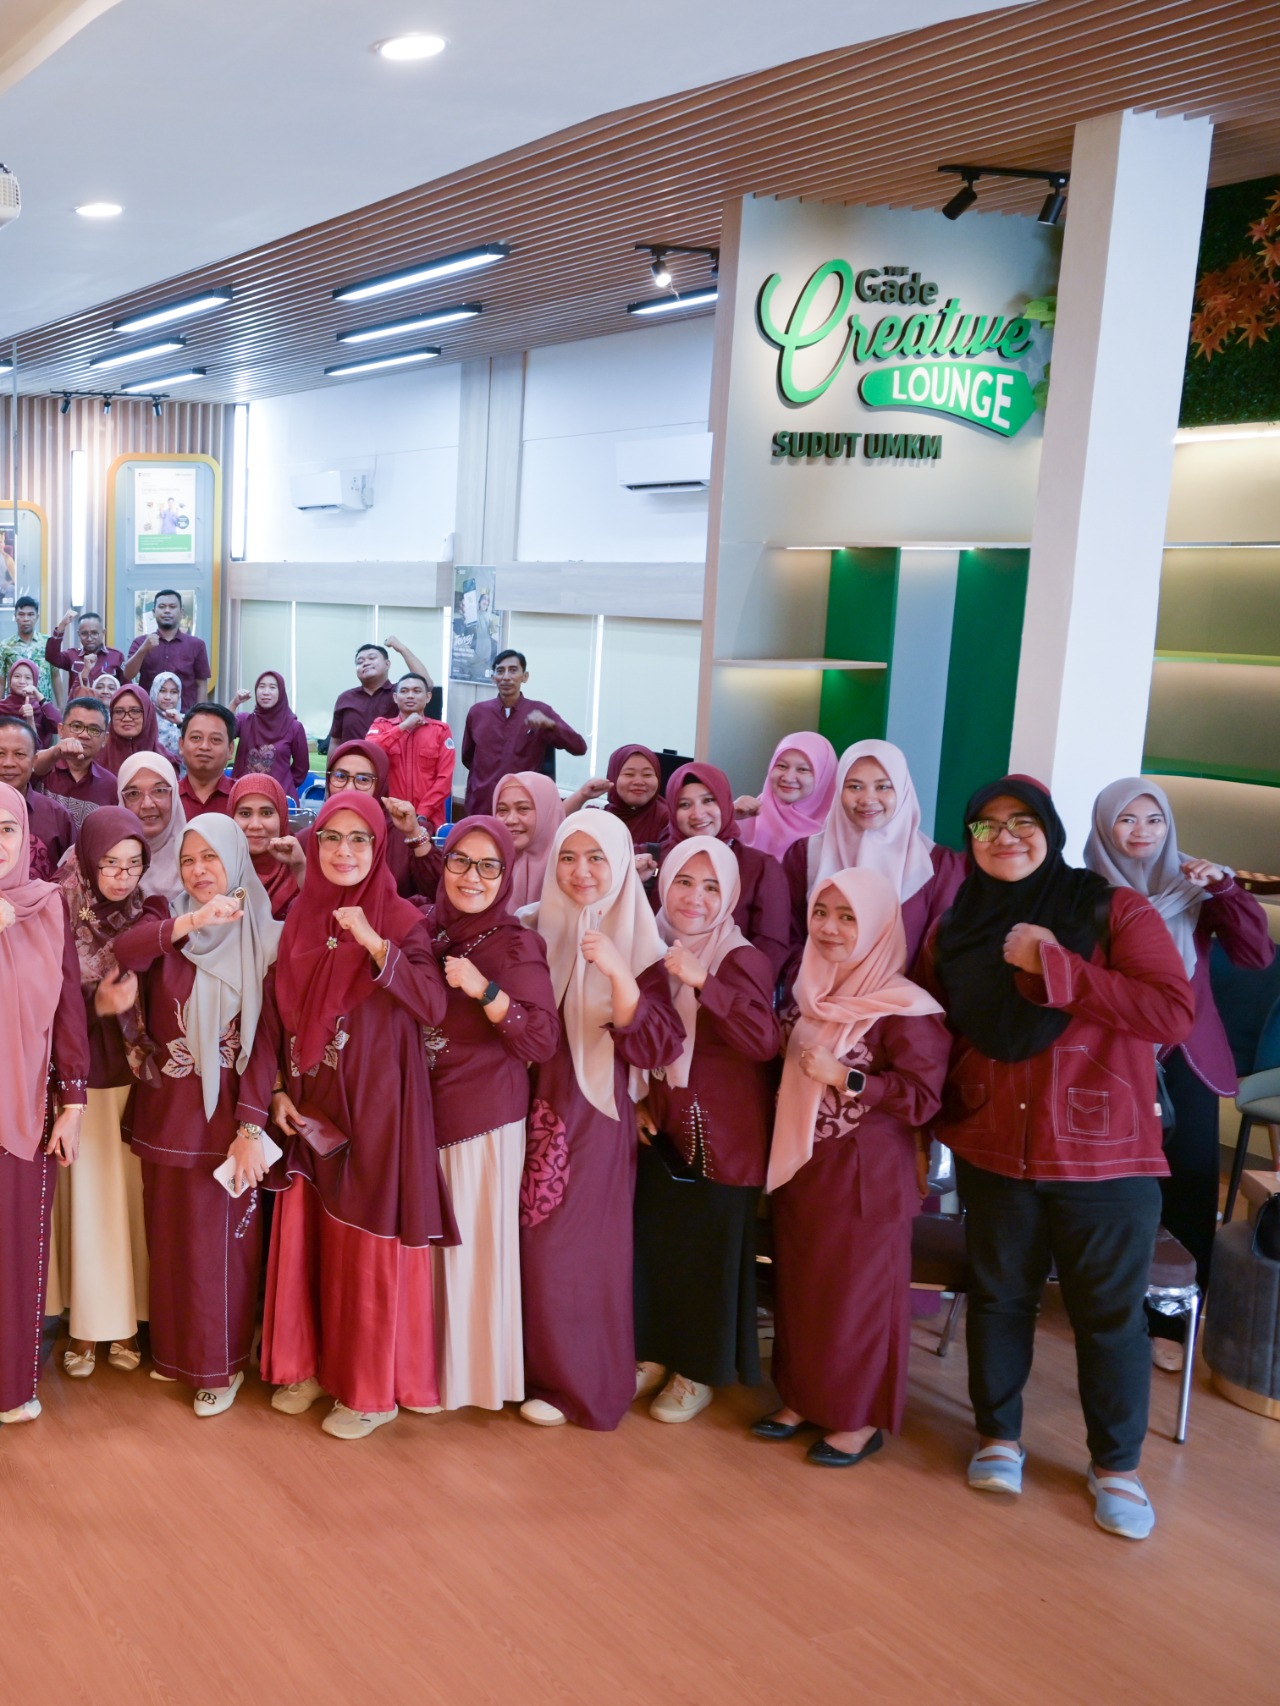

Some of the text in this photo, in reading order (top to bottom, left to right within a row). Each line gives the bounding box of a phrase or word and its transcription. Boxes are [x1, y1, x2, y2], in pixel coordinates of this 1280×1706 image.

[854, 268, 939, 305] Gade
[756, 258, 1035, 404] Creative
[891, 365, 1015, 430] LOUNGE
[772, 430, 943, 460] SUDUT UMKM
